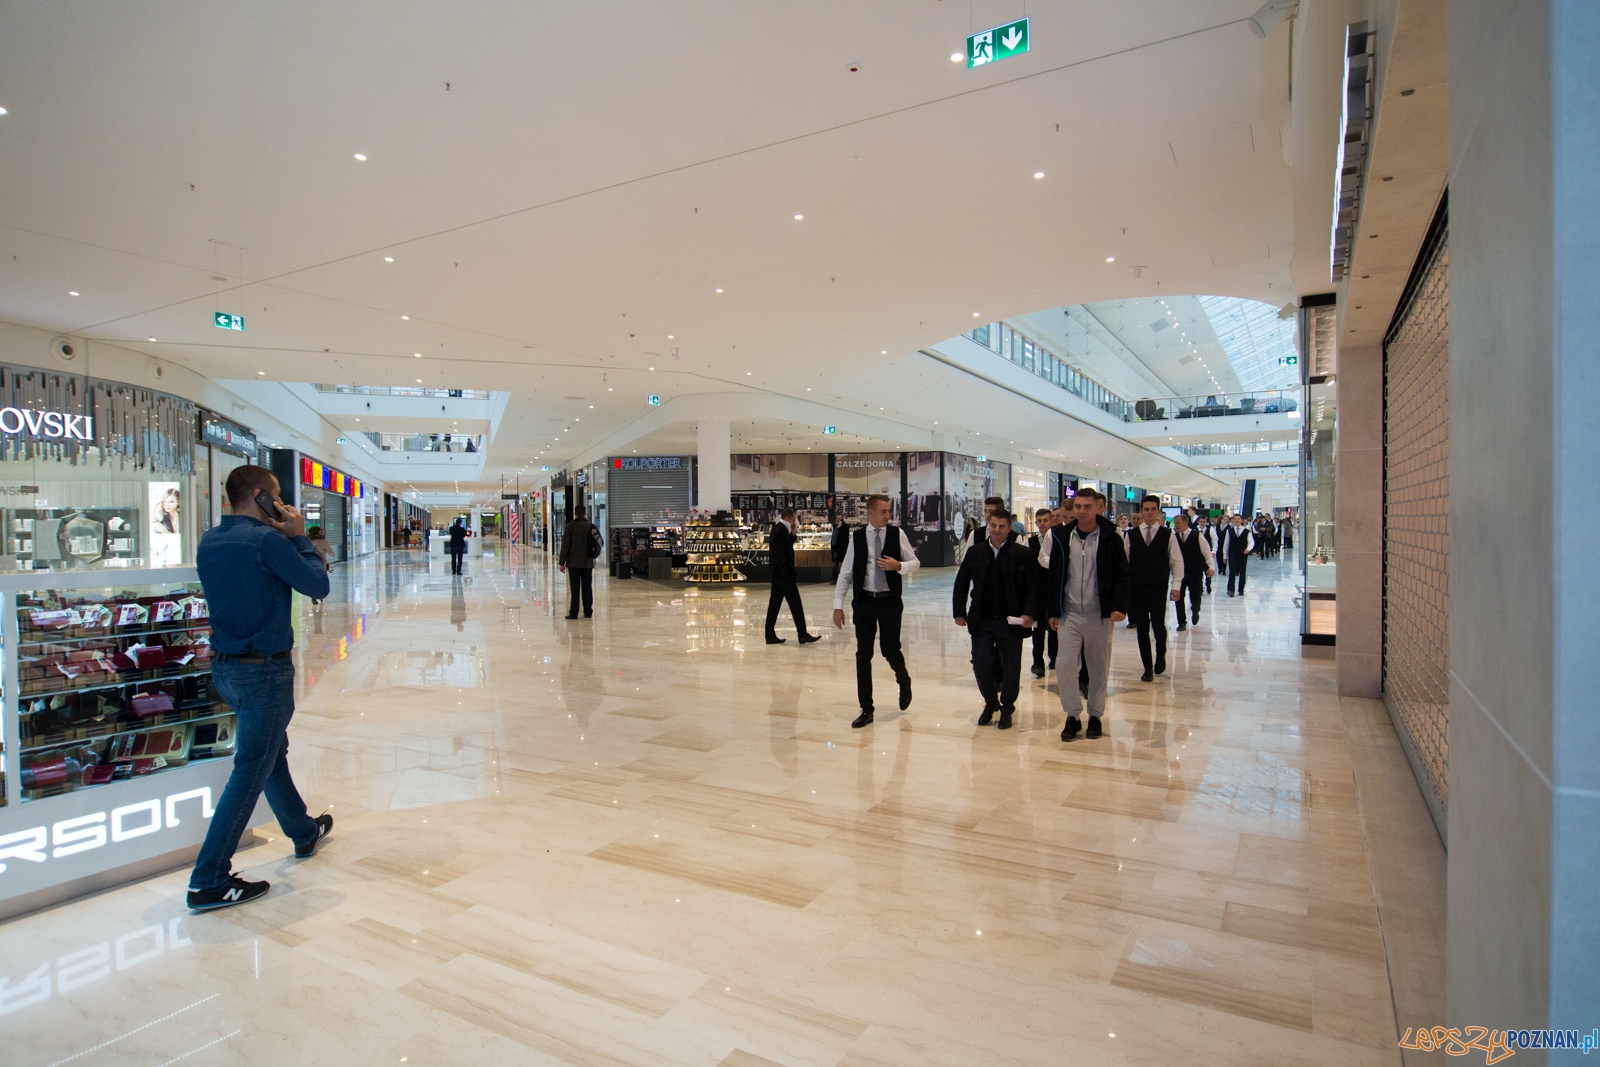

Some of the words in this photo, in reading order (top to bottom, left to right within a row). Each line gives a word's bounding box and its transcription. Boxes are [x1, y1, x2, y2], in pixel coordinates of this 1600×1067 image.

[0, 407, 93, 440] OVSKI
[621, 457, 681, 469] KOLPORTER
[836, 460, 894, 468] CALZEDONIA
[963, 463, 999, 480] CALZEDONIA
[222, 887, 245, 901] N
